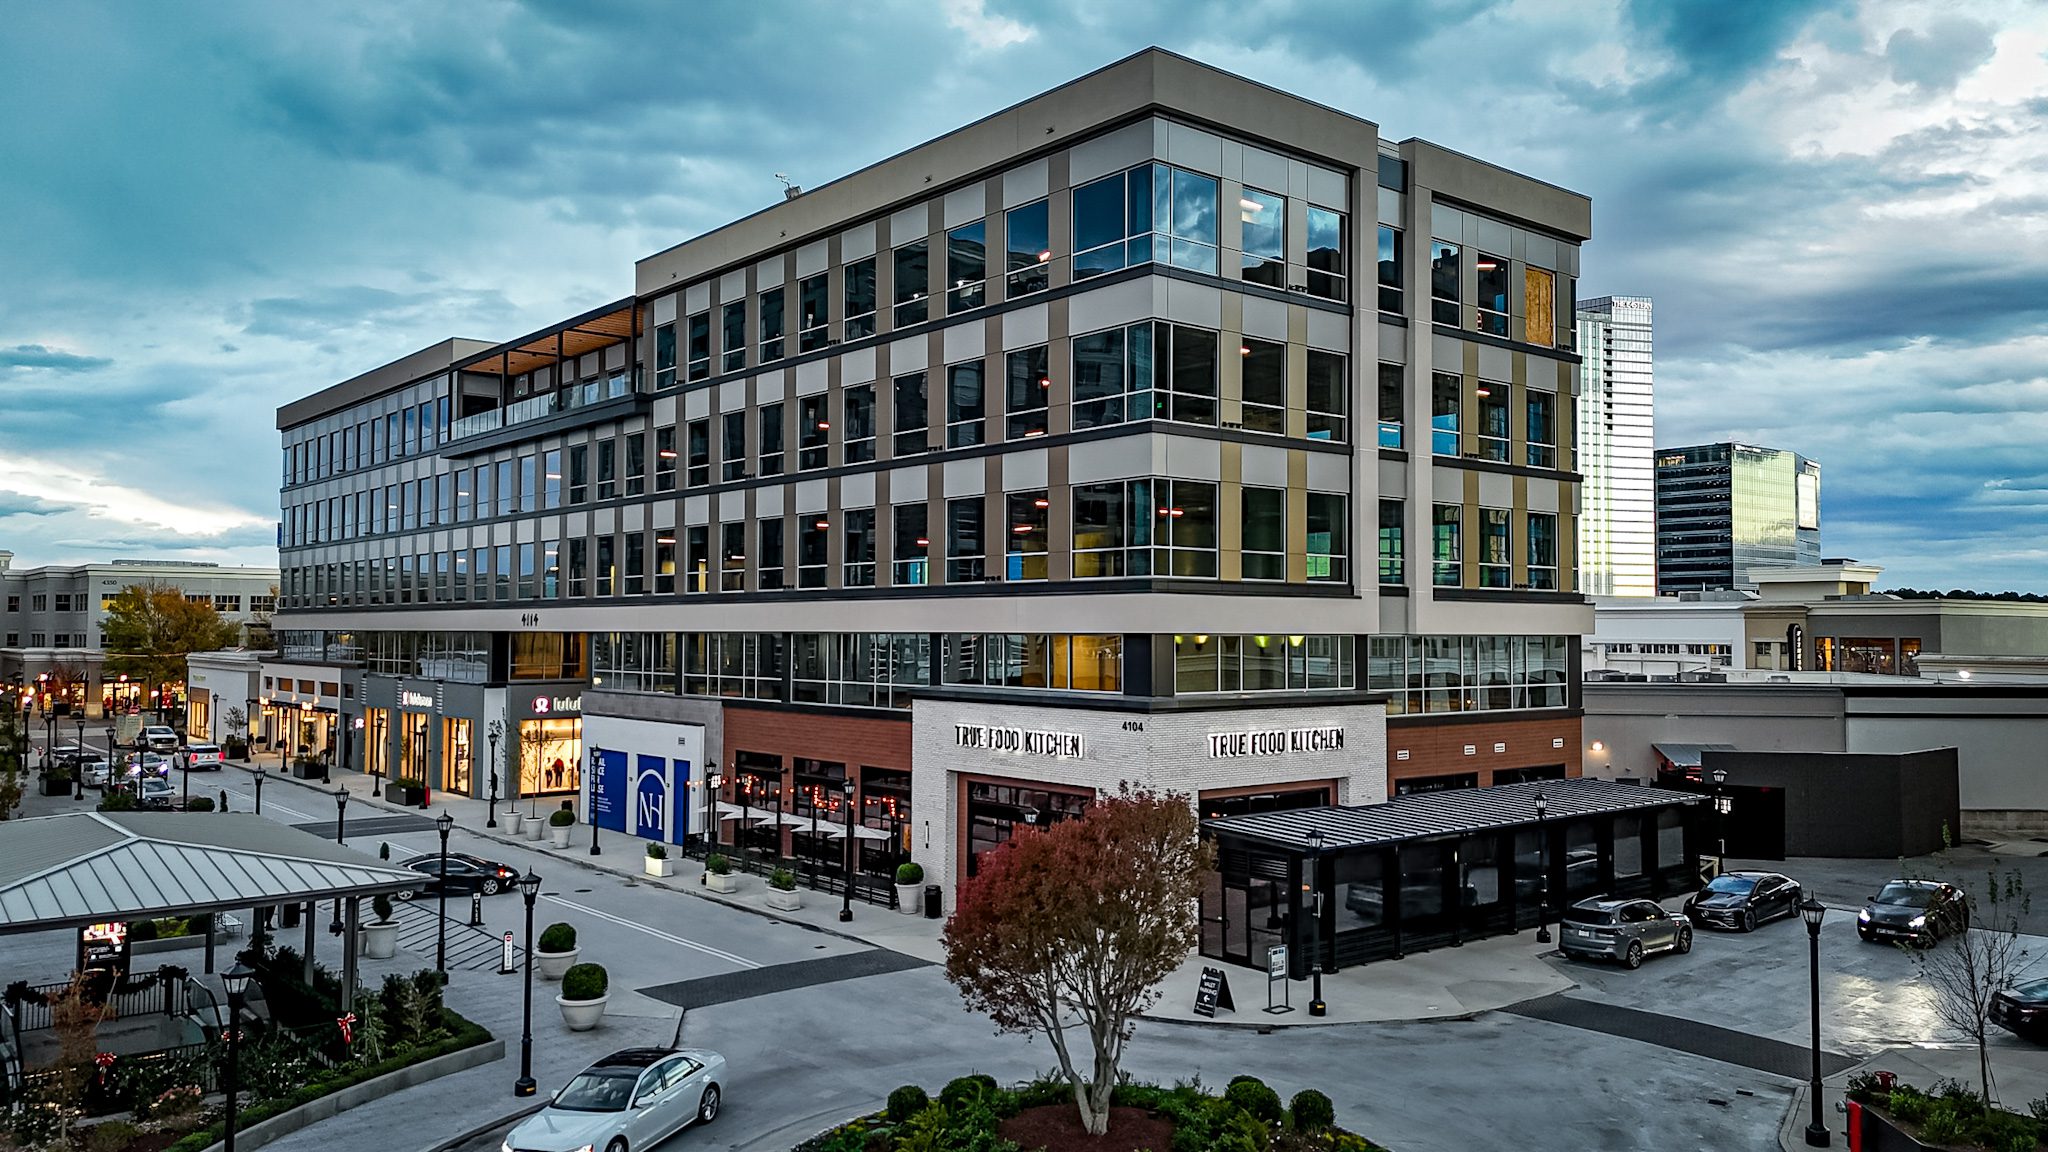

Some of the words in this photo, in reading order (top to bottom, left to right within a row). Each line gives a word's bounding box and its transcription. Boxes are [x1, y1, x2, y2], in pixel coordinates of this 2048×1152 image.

[521, 613, 539, 627] 4114
[1121, 721, 1144, 732] 4104
[954, 724, 986, 747] TRUE
[988, 727, 1021, 751] FOOD
[1025, 731, 1082, 758] KITCHEN
[1210, 733, 1246, 757] TRUE
[1251, 731, 1286, 755] FOOD
[1291, 728, 1345, 751] KITCHEN
